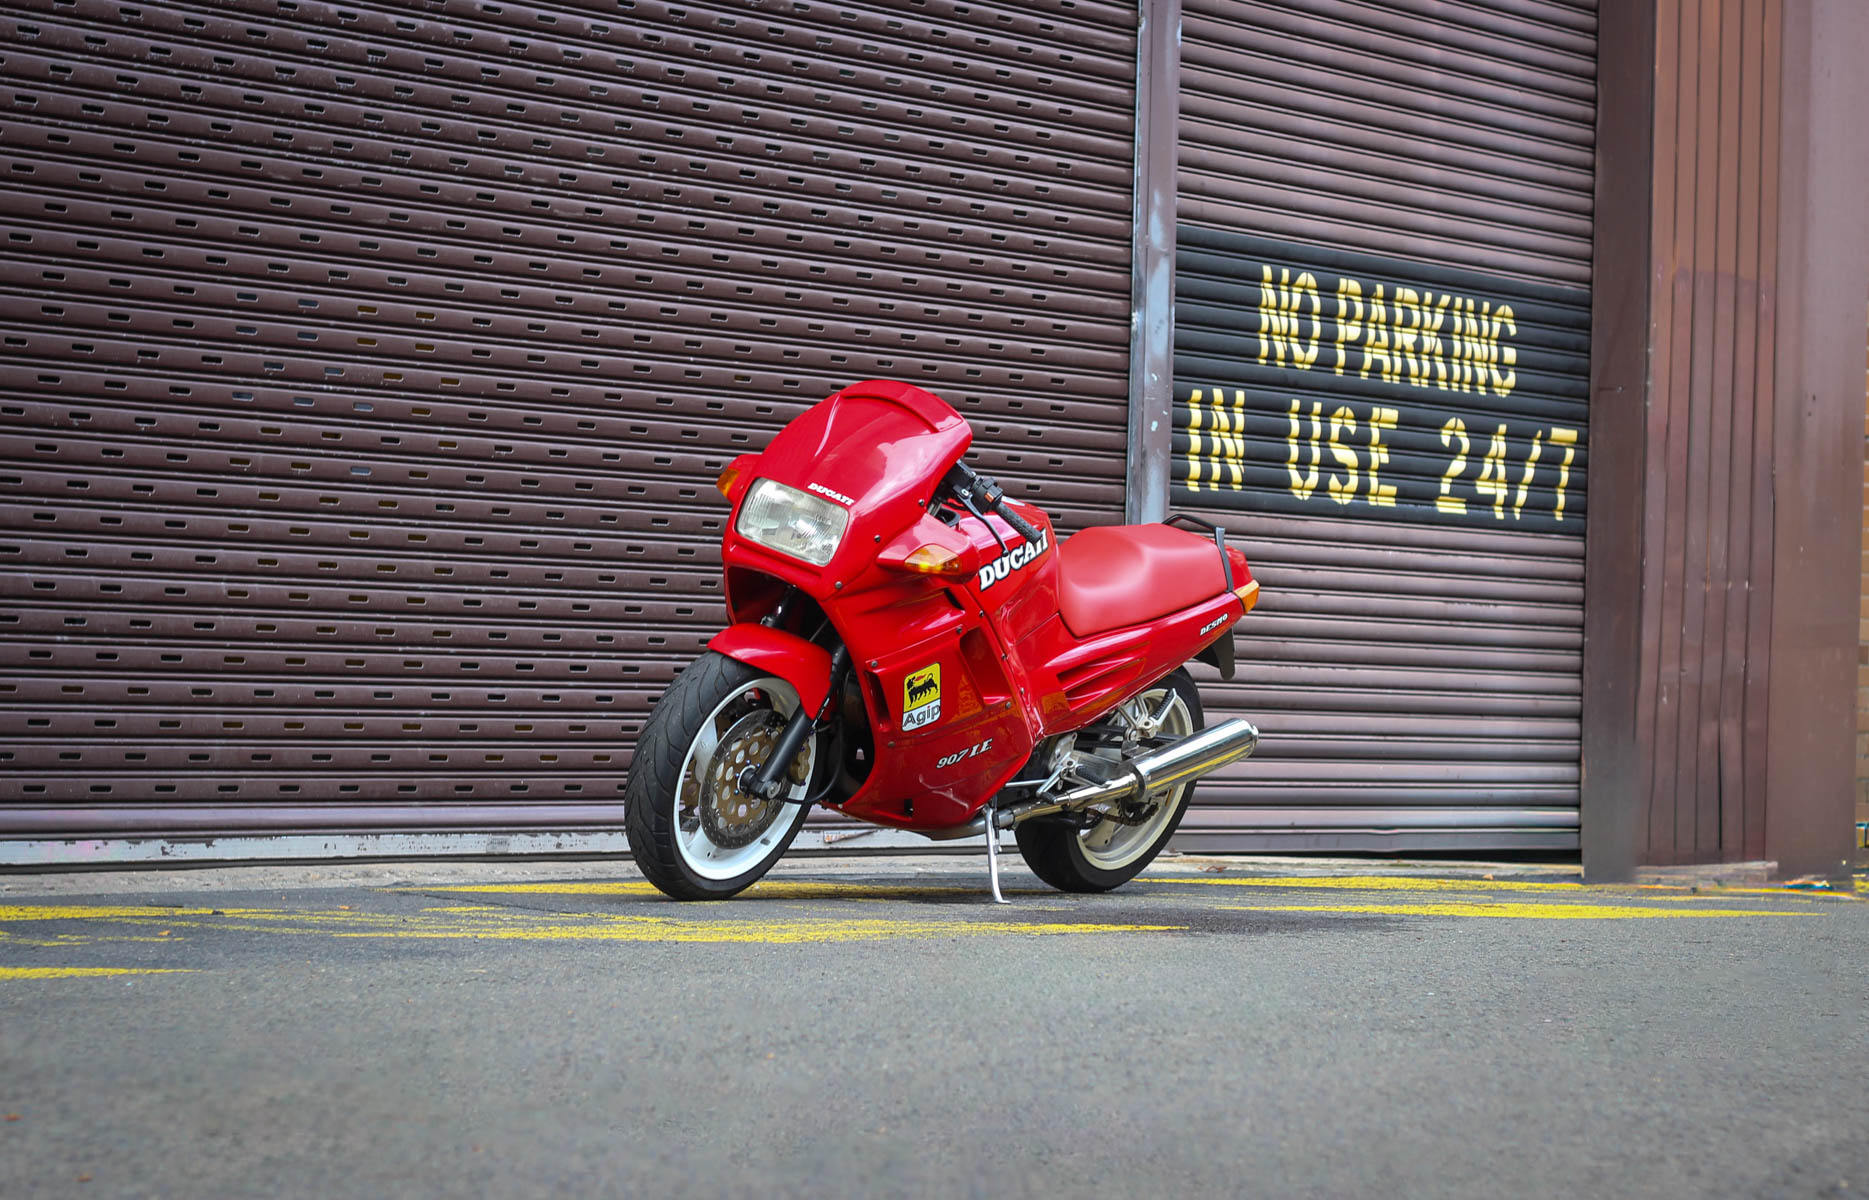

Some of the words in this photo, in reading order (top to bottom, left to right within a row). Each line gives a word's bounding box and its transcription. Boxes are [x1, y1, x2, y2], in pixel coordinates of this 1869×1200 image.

[1257, 265, 1321, 370] NO
[1334, 277, 1518, 398] PARKING
[1186, 388, 1245, 492] IN
[1286, 399, 1399, 507] USE
[1436, 416, 1578, 521] 24/7
[807, 482, 855, 506] DUCATI
[1200, 613, 1229, 636] DESMO
[903, 705, 941, 727] Agip
[936, 748, 969, 769] 907
